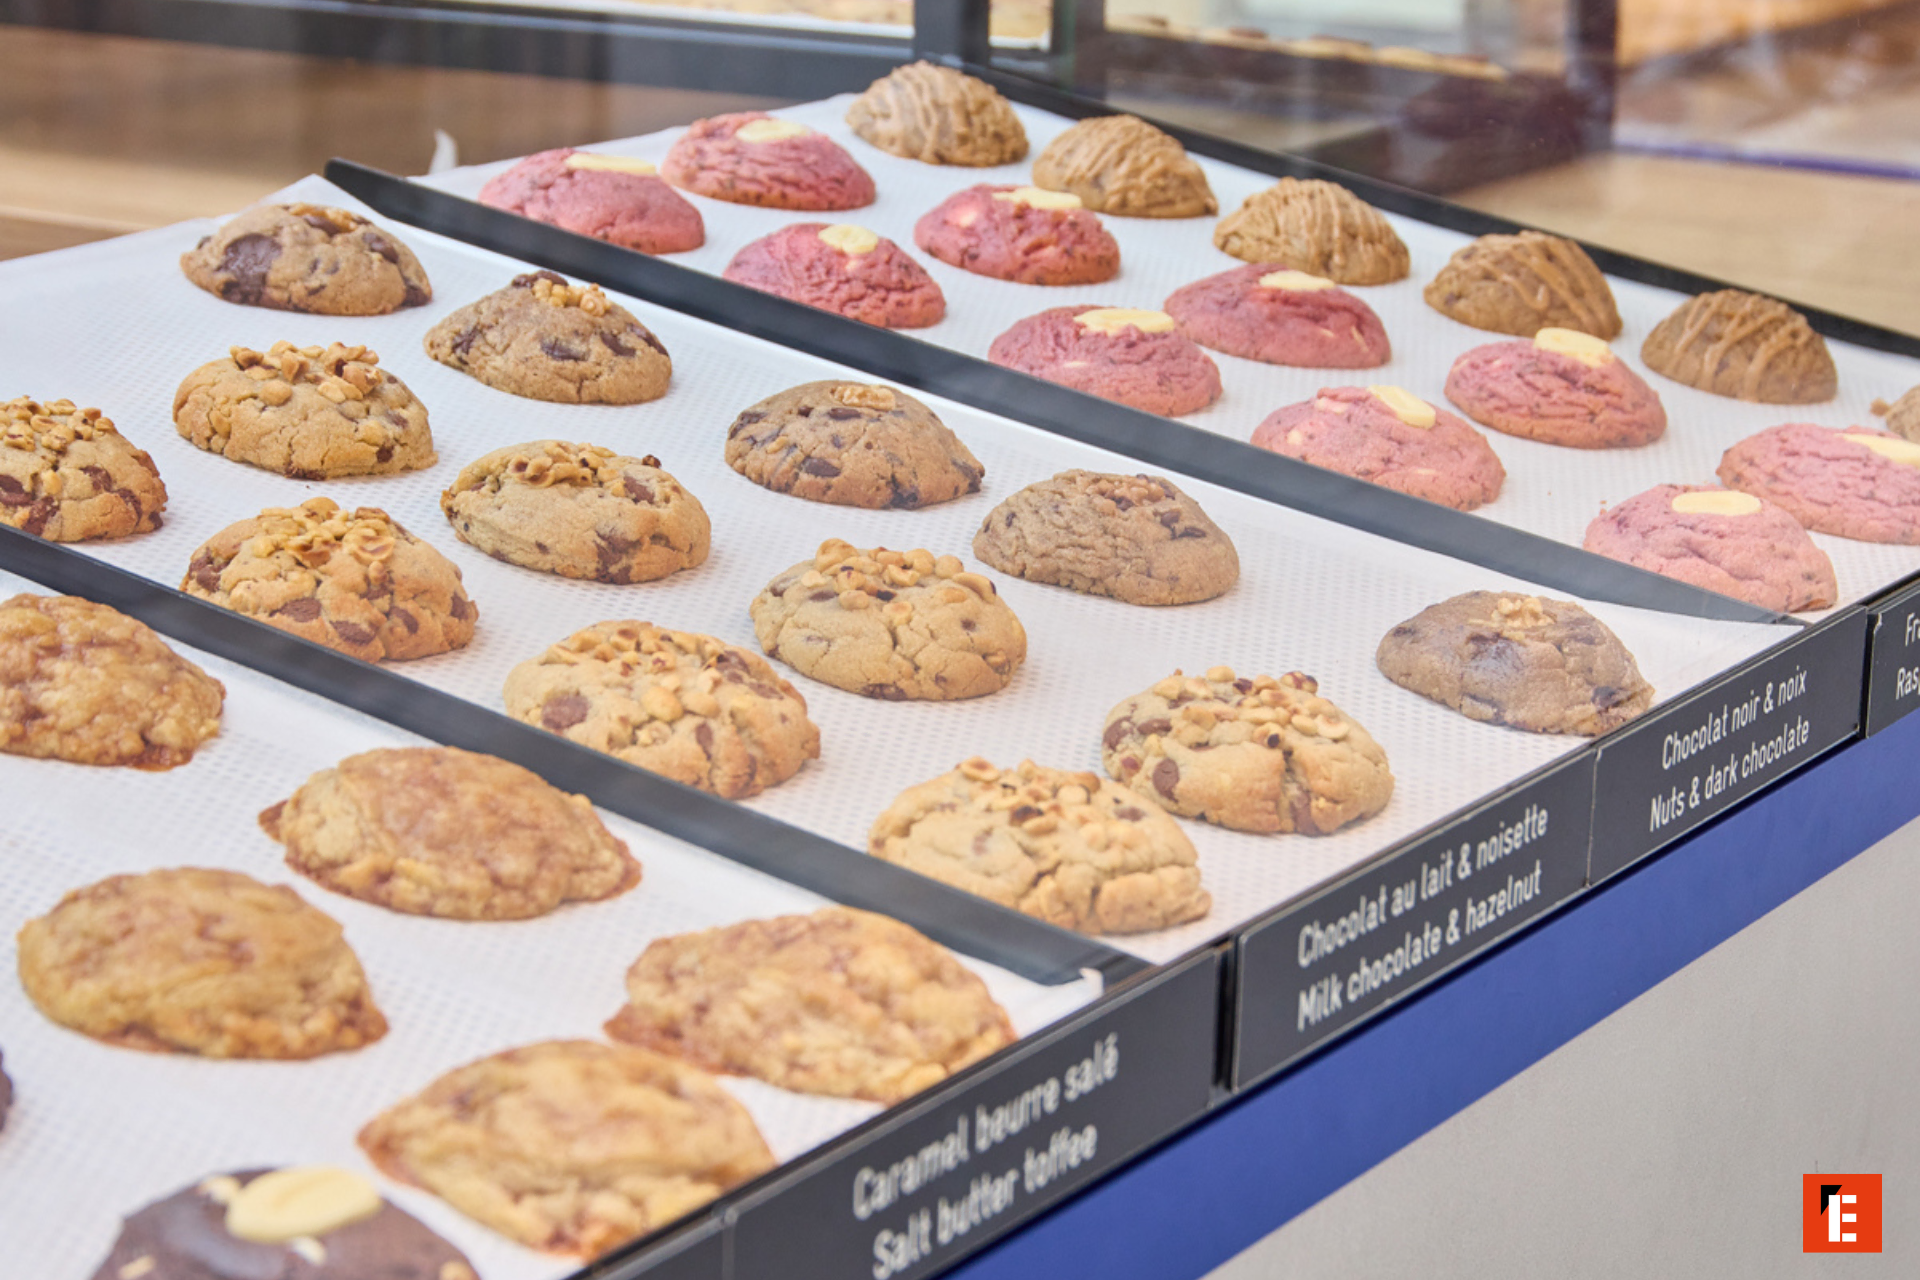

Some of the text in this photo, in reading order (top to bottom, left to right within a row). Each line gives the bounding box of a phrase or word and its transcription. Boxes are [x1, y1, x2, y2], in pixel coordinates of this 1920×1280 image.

[1905, 612, 1920, 647] Fr
[1650, 715, 1810, 833] Nuts & dark chocolate
[1662, 665, 1807, 770] Chocolat noir & noix
[1297, 859, 1542, 1031] Milk chocolate & hazelnut
[1298, 803, 1549, 968] Chocolat au lait & noisette
[853, 1032, 1119, 1220] Caramel beurre salé
[872, 1124, 1098, 1280] Salt butter toffee
